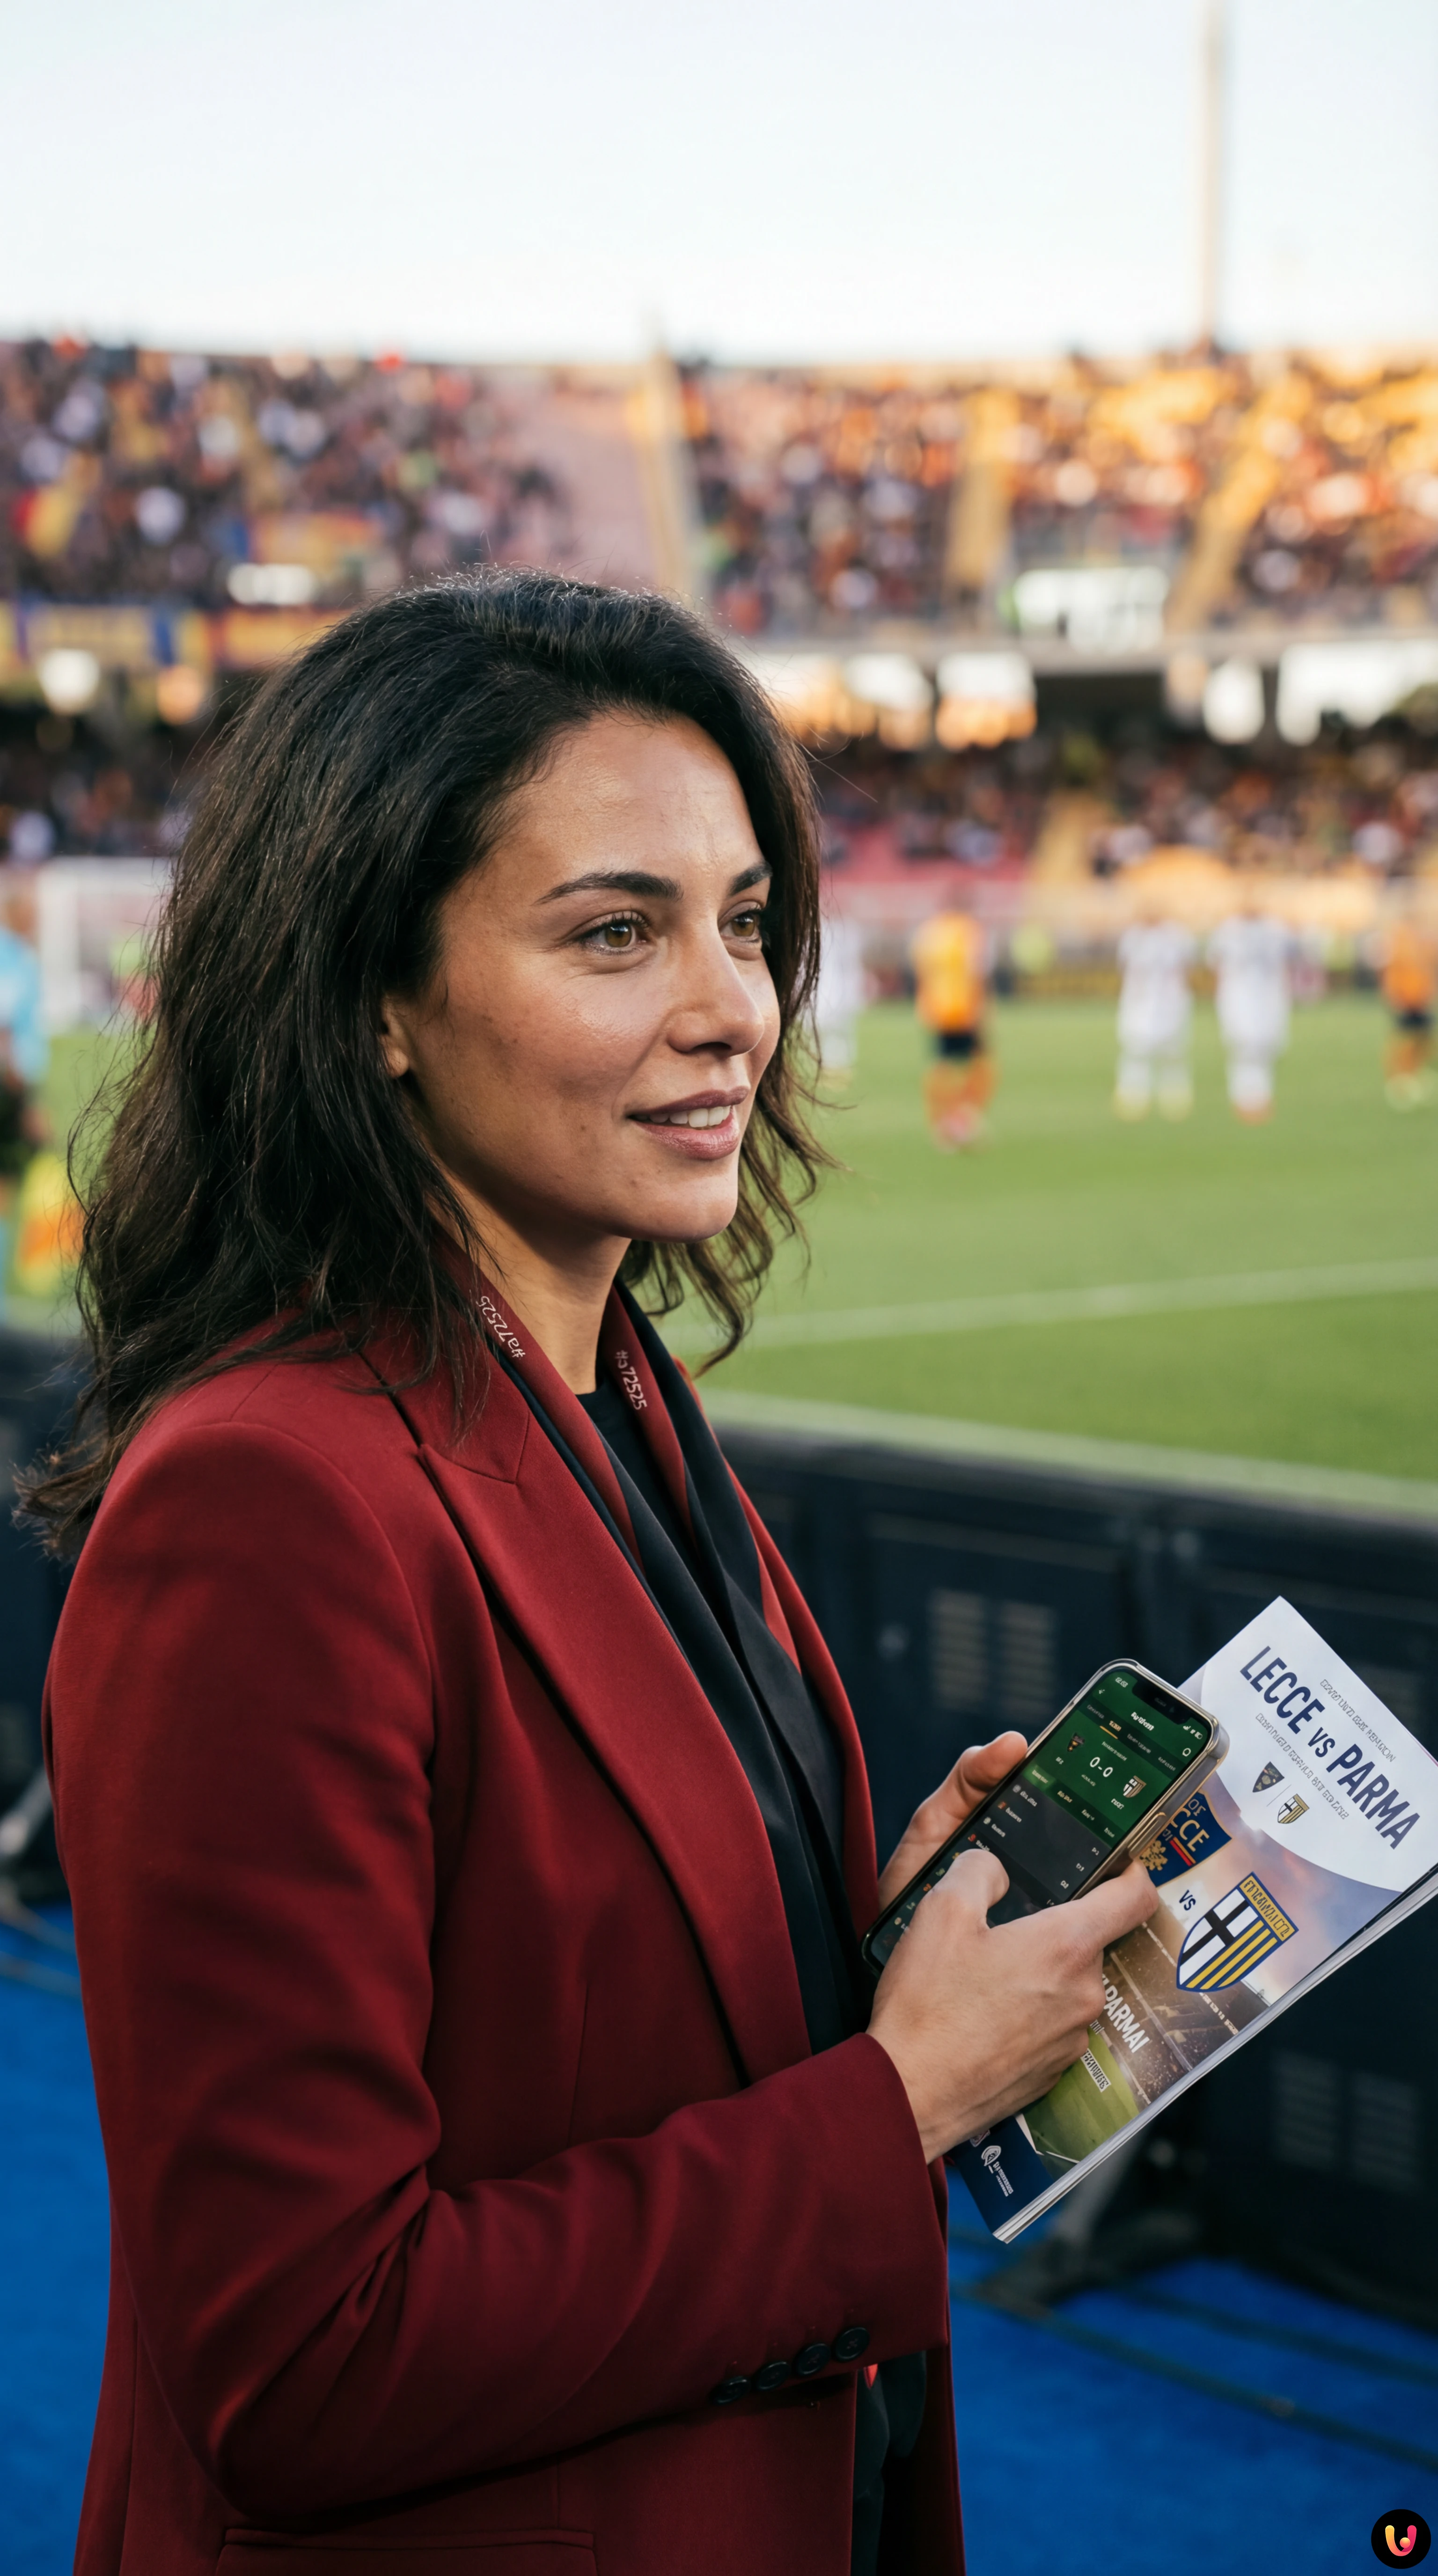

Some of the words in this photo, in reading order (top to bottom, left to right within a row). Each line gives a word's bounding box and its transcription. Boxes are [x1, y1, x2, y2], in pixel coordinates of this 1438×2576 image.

[476, 1295, 526, 1358] #a72525
[1240, 1646, 1326, 1734] LECCE
[1326, 1743, 1420, 1850] PARMA
